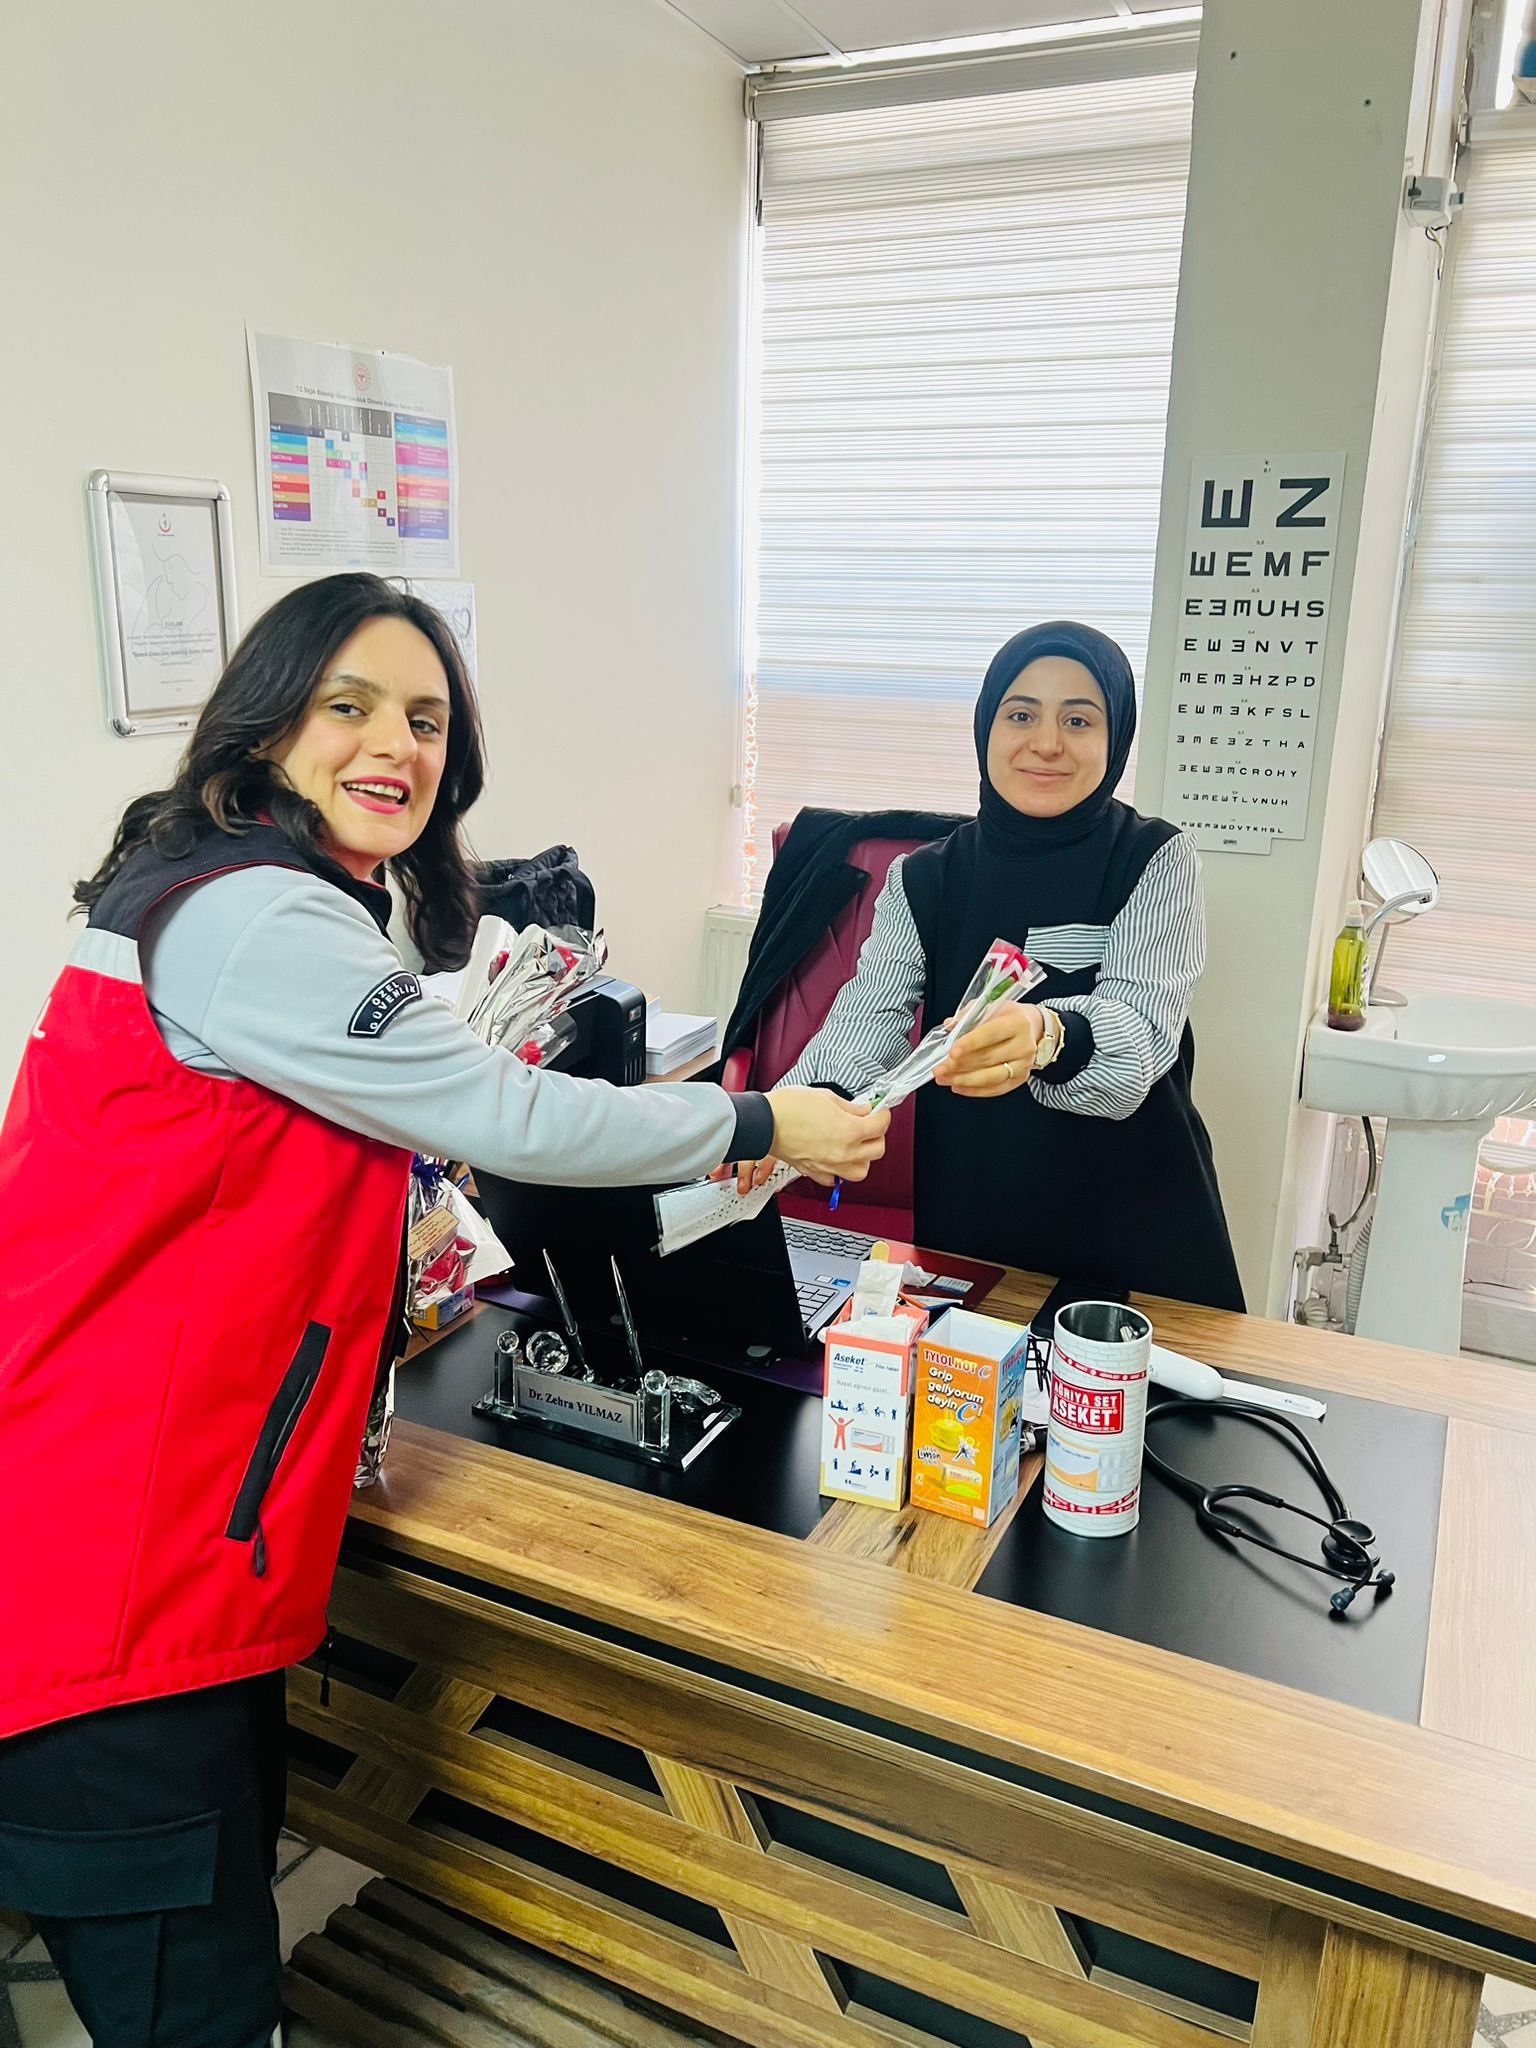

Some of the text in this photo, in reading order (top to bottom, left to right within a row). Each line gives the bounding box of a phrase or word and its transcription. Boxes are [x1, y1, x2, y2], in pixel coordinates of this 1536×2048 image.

[834, 1353, 865, 1366] Aseket
[929, 1367, 953, 1382] Grip
[927, 1394, 958, 1410] deyin
[928, 1382, 984, 1404] geliyorum
[1053, 1381, 1118, 1408] AĞRIYA SET
[528, 1388, 623, 1424] Dr. Zehra YILMAZ
